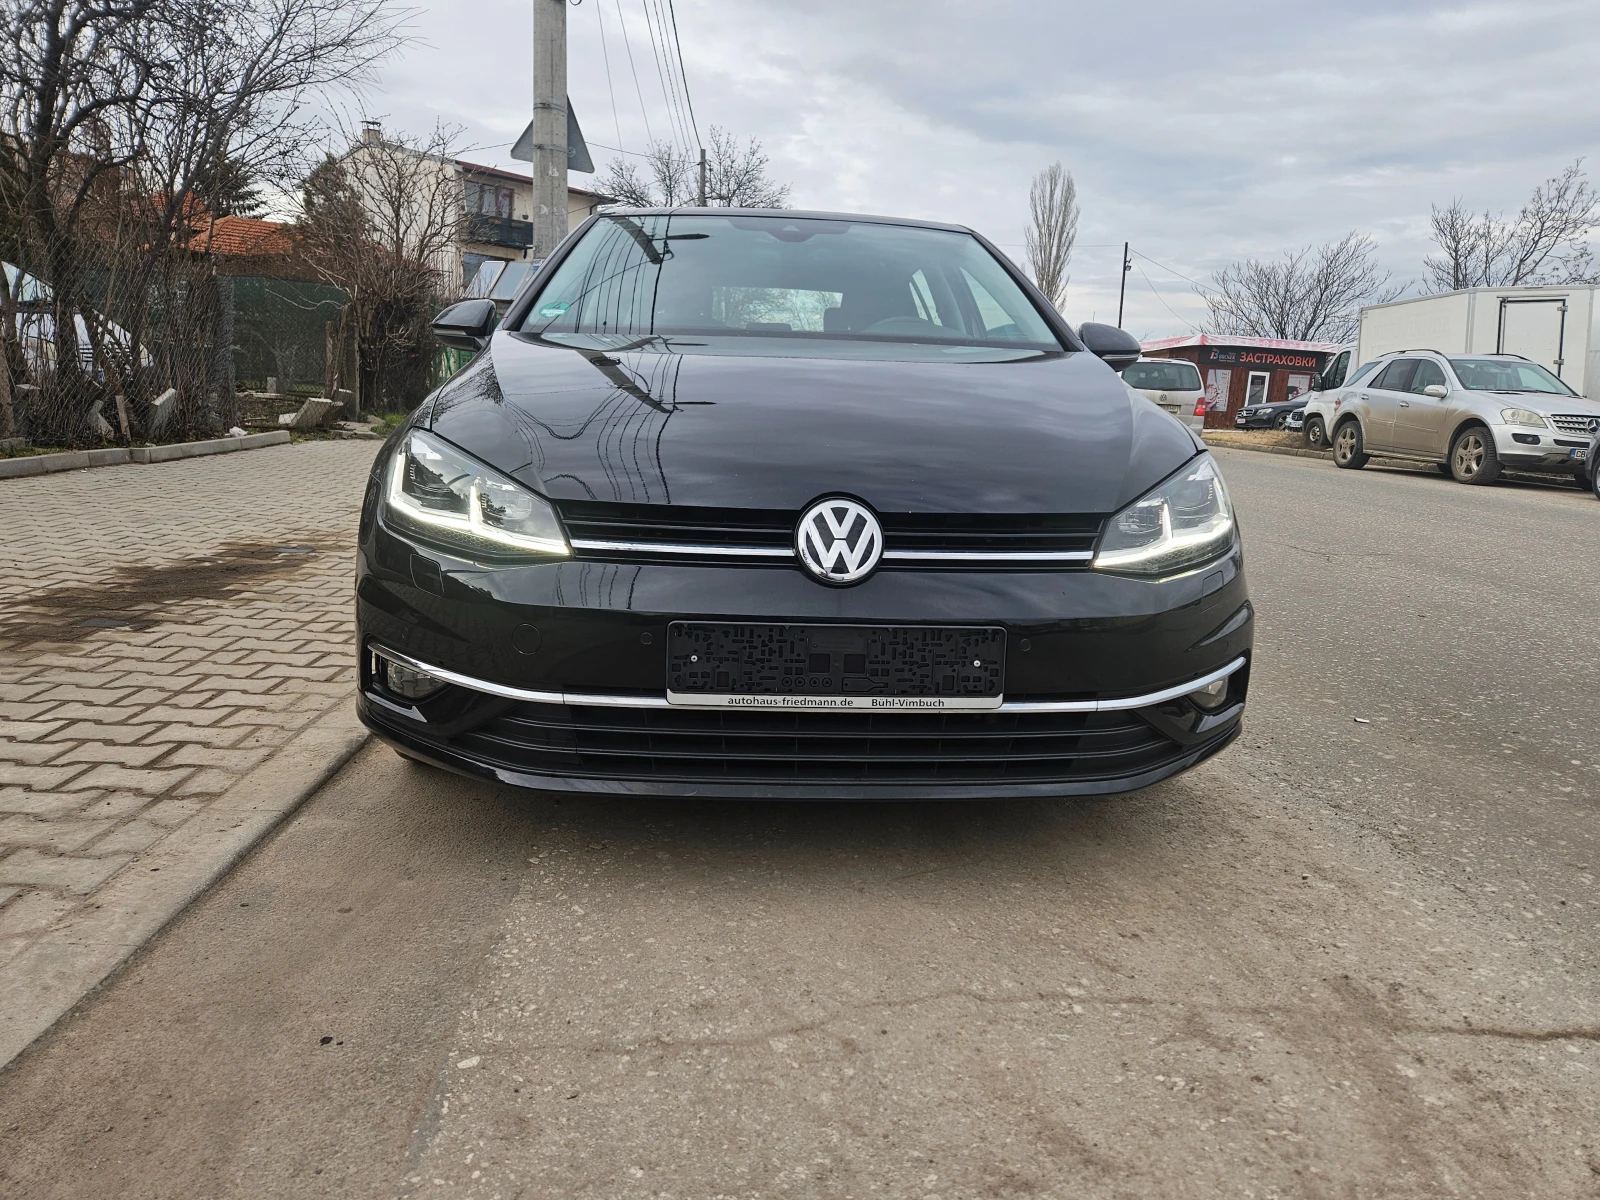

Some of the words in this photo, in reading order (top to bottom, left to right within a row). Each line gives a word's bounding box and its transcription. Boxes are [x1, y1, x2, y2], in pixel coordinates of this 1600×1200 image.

[1239, 352, 1317, 367] ЗАСТРАХОВКИ
[798, 500, 882, 580] VW
[727, 696, 854, 707] autohaus-friedmann.de
[871, 698, 945, 707] Bühl-Vimbuch
